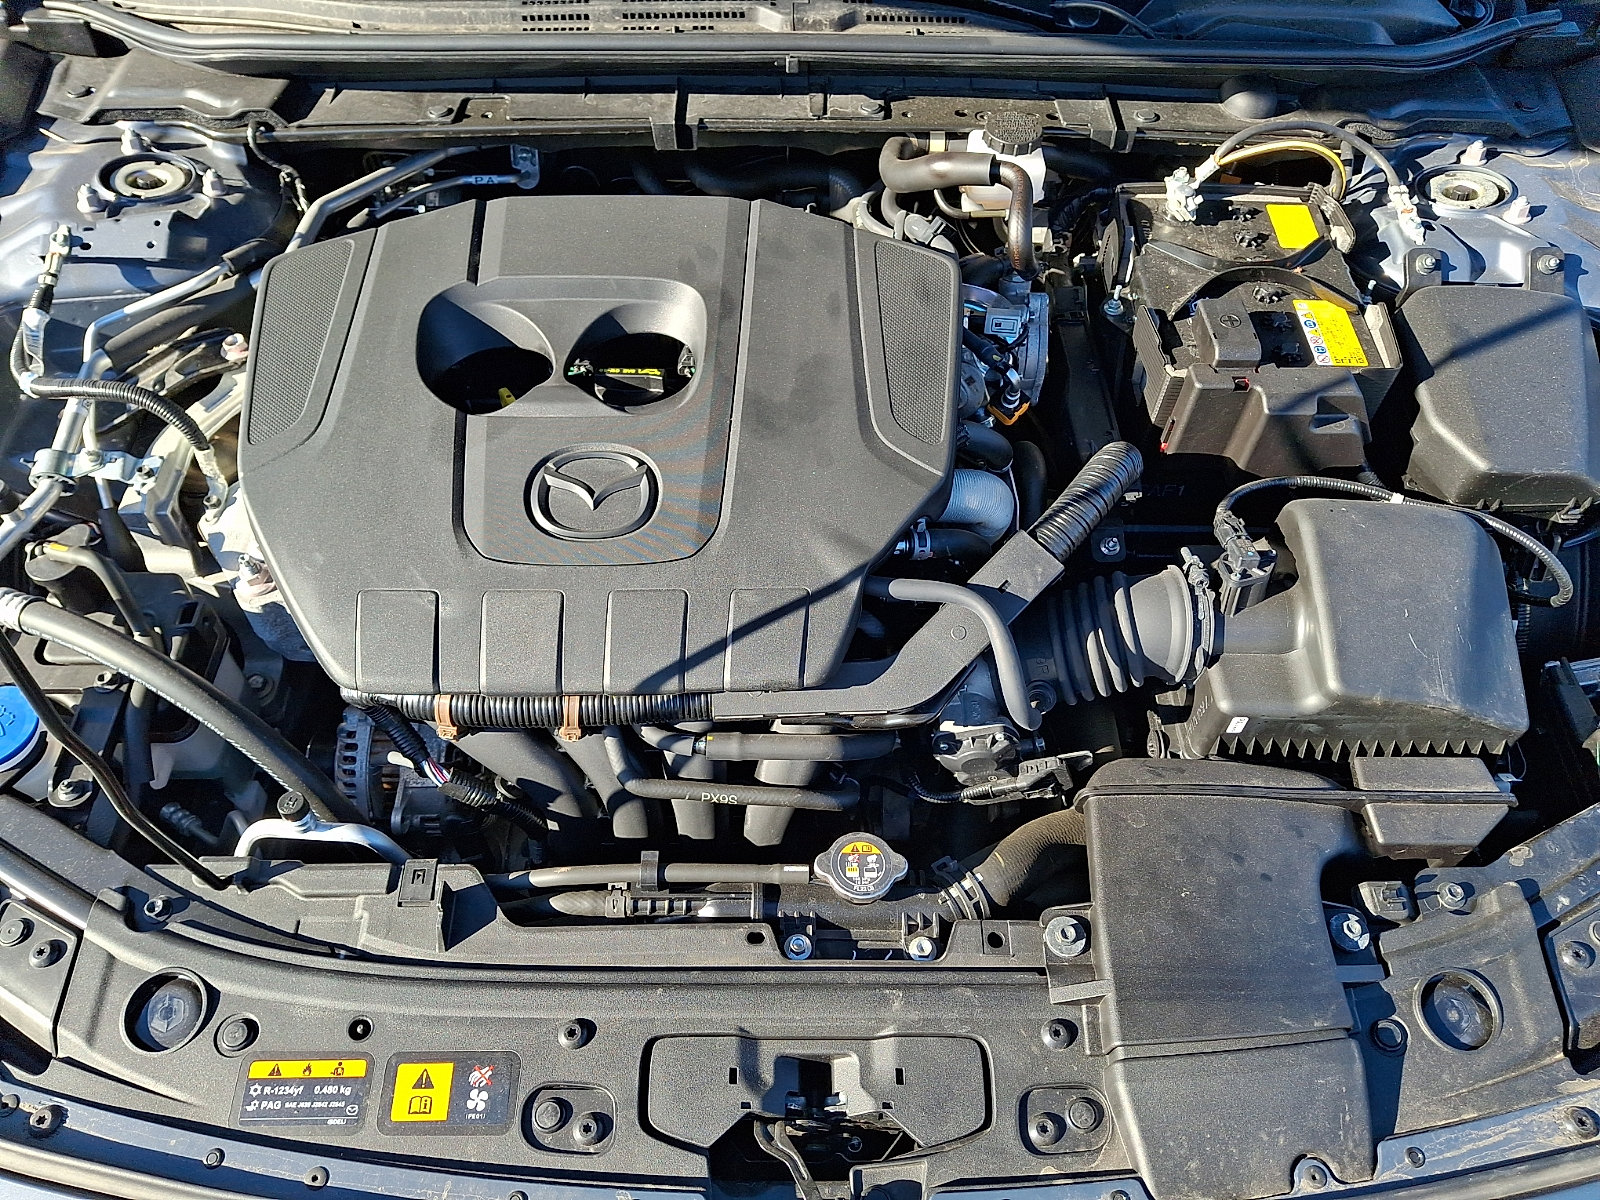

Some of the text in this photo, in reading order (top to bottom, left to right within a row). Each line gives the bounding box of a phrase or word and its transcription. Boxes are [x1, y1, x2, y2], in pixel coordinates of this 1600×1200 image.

[263, 1085, 304, 1097] R-1234yf
[339, 1085, 352, 1096] kg
[260, 1100, 282, 1110] PAG
